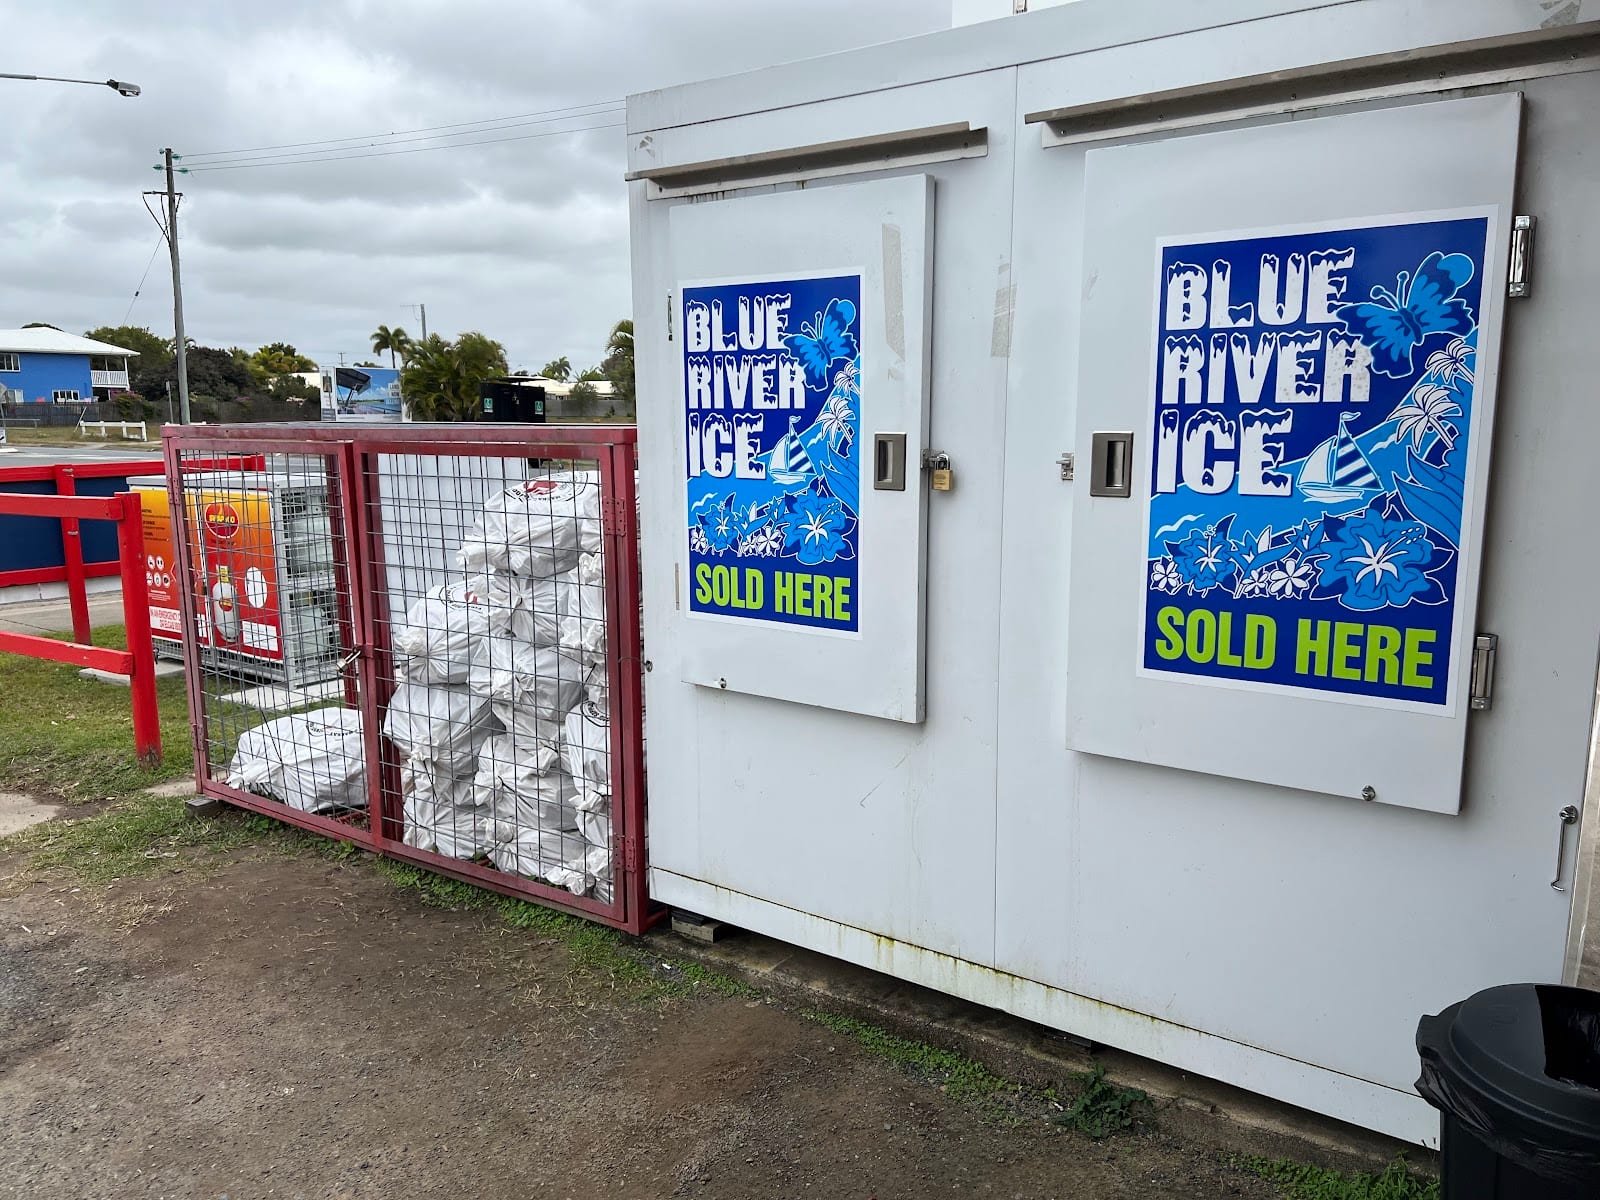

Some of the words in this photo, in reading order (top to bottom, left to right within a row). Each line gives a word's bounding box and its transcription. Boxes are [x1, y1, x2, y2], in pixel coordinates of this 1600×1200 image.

[686, 293, 792, 352] BLUE
[1166, 248, 1354, 330] BLUE
[688, 354, 807, 410] RIVER
[1163, 329, 1373, 403] RIVER
[689, 412, 767, 480] ICE
[1157, 408, 1293, 496] ICE
[696, 563, 763, 609] SOLD
[775, 571, 850, 620] HERE
[1156, 606, 1276, 669] SOLD
[1296, 619, 1436, 688] HERE
